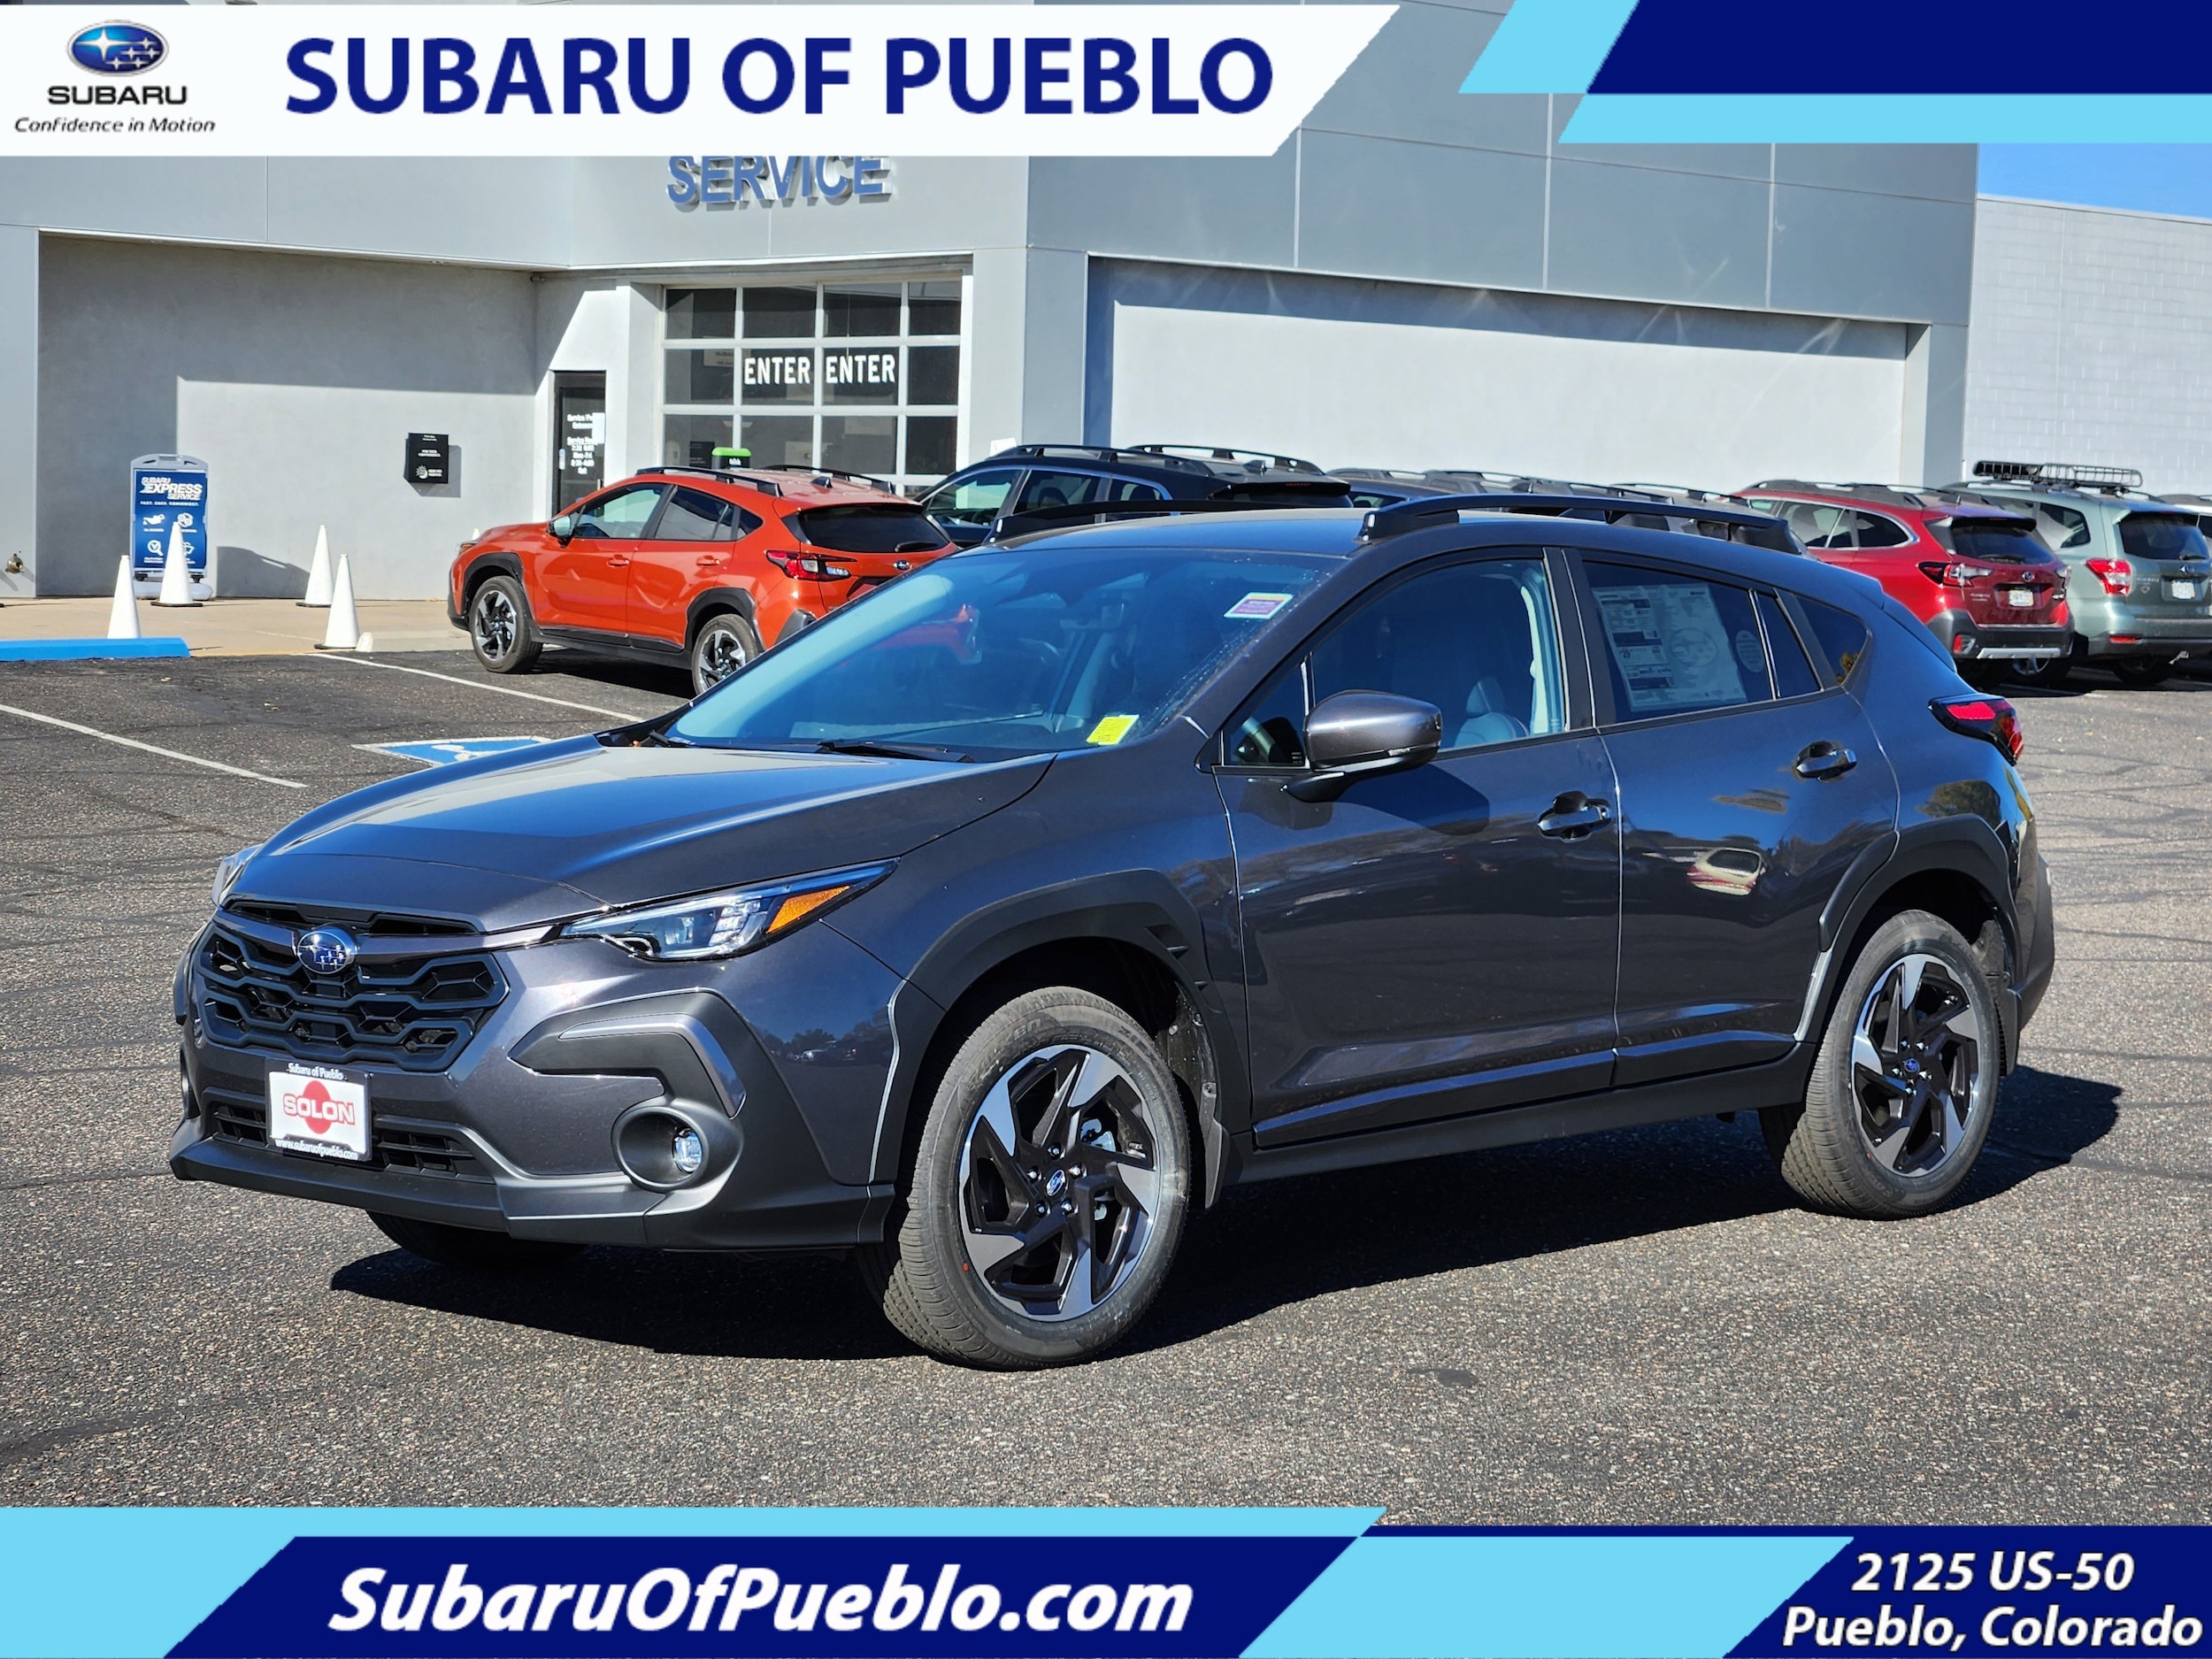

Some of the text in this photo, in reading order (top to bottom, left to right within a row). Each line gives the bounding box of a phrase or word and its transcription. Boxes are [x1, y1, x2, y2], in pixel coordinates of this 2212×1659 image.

[665, 156, 890, 205] SERVICE
[744, 357, 811, 385] ENTER
[826, 354, 895, 384] ENTER
[140, 483, 203, 494] EXPRESS
[288, 1063, 344, 1080] Subaru of Pueblo
[283, 1093, 356, 1126] SOLON
[275, 1139, 359, 1161] www.subaruofpueblo.com
